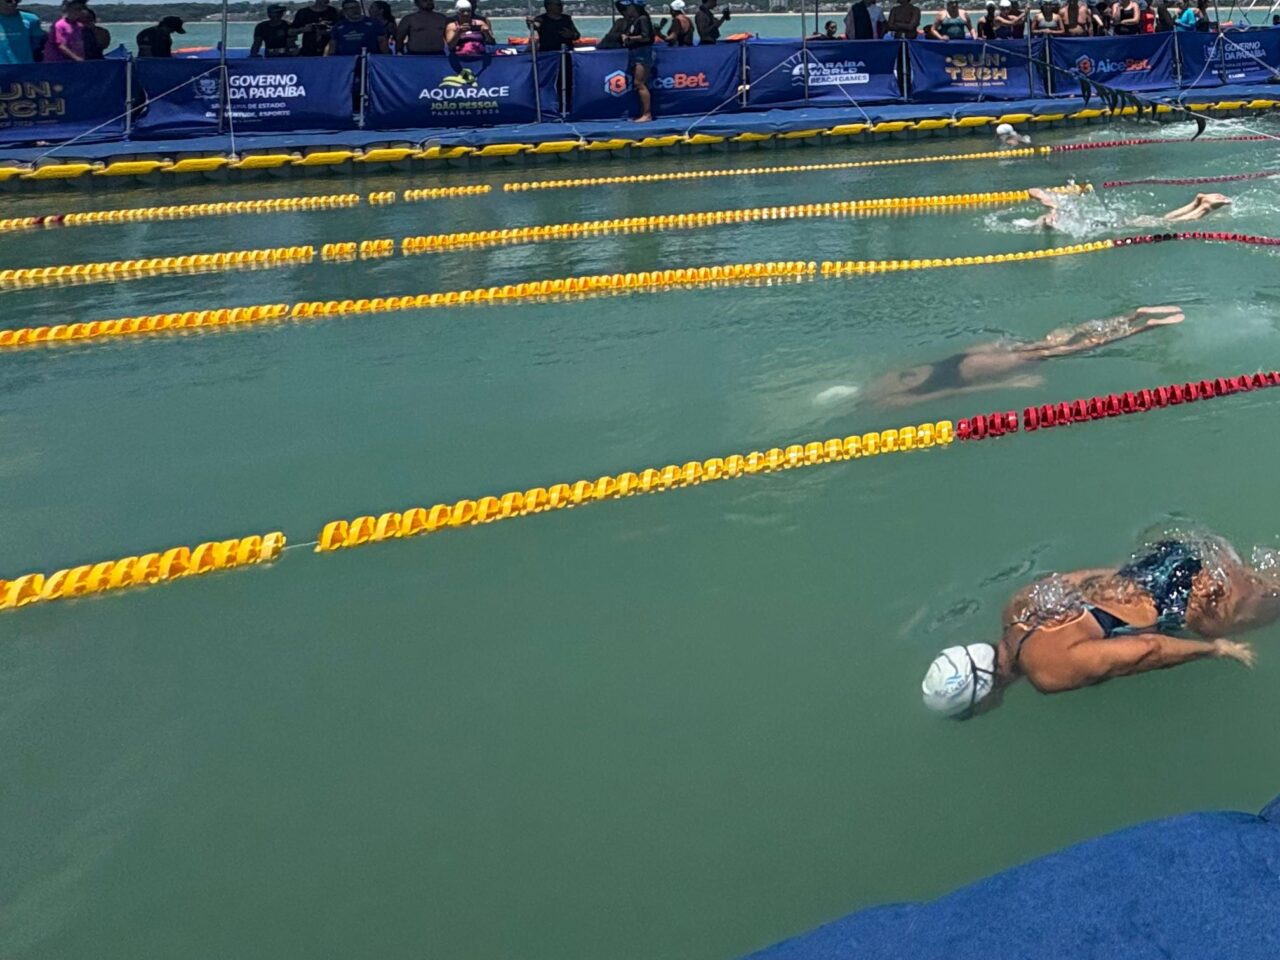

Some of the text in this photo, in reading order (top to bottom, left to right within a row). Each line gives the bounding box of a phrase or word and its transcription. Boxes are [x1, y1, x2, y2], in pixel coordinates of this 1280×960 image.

[229, 74, 298, 87] GOVERNO
[944, 67, 1007, 81] TECH
[229, 85, 306, 99] DA PARAÍBA
[418, 86, 510, 101] AQUARACE
